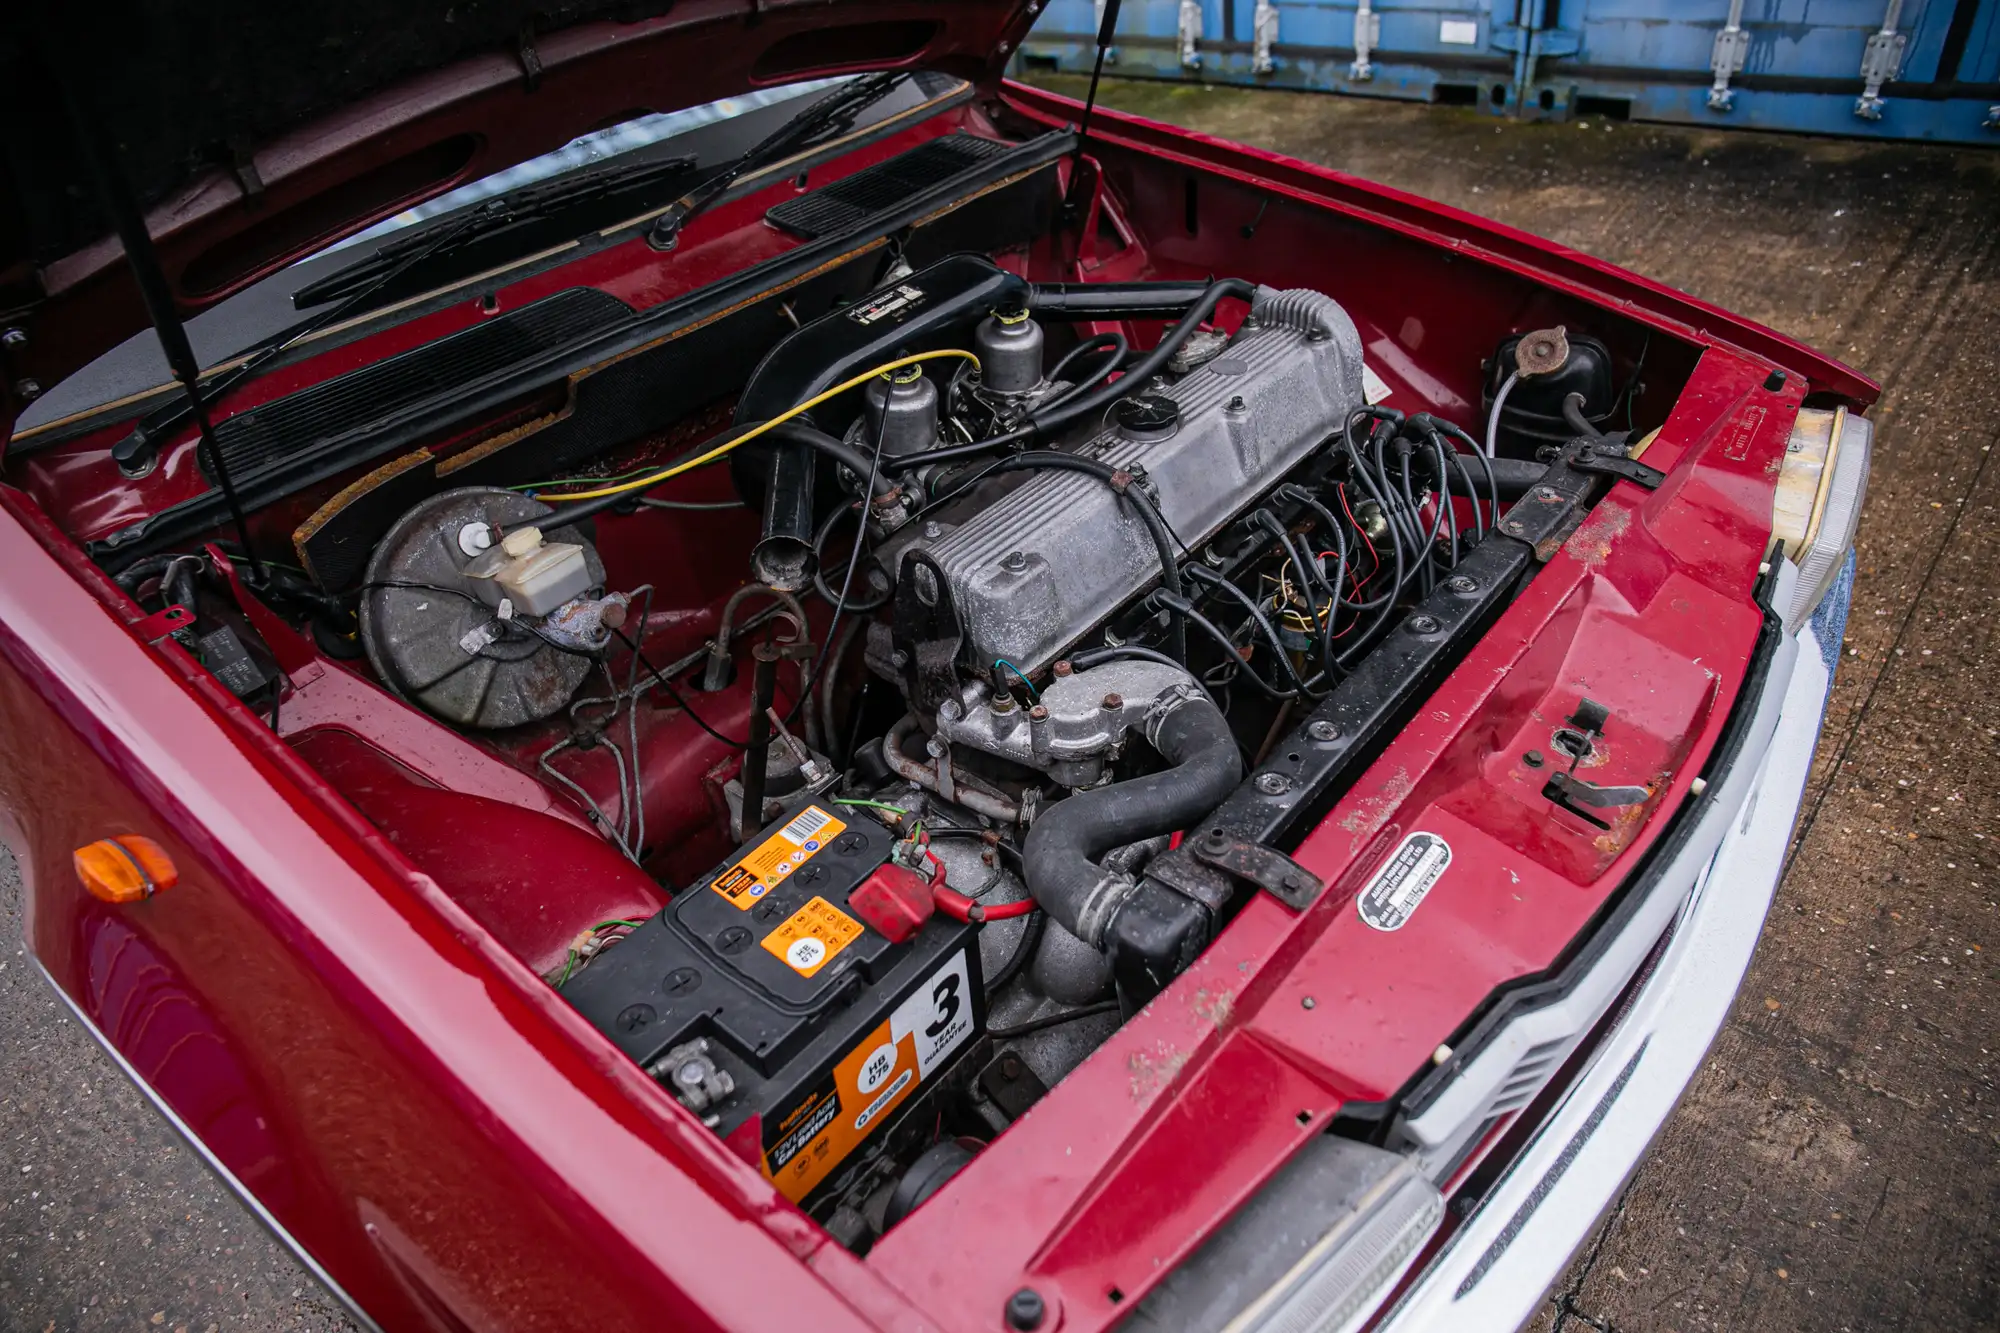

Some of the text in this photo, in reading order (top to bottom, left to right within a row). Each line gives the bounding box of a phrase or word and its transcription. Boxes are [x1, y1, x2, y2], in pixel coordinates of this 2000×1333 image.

[1399, 844, 1415, 862] GROUP
[796, 944, 811, 957] HB
[925, 972, 960, 1038] 3
[924, 1019, 967, 1065] GUARANTEE
[934, 1022, 957, 1047] YEAR
[868, 1054, 886, 1075] HB
[868, 1063, 889, 1086] 075
[778, 1143, 797, 1166] Car
[797, 1107, 836, 1148] Battery
